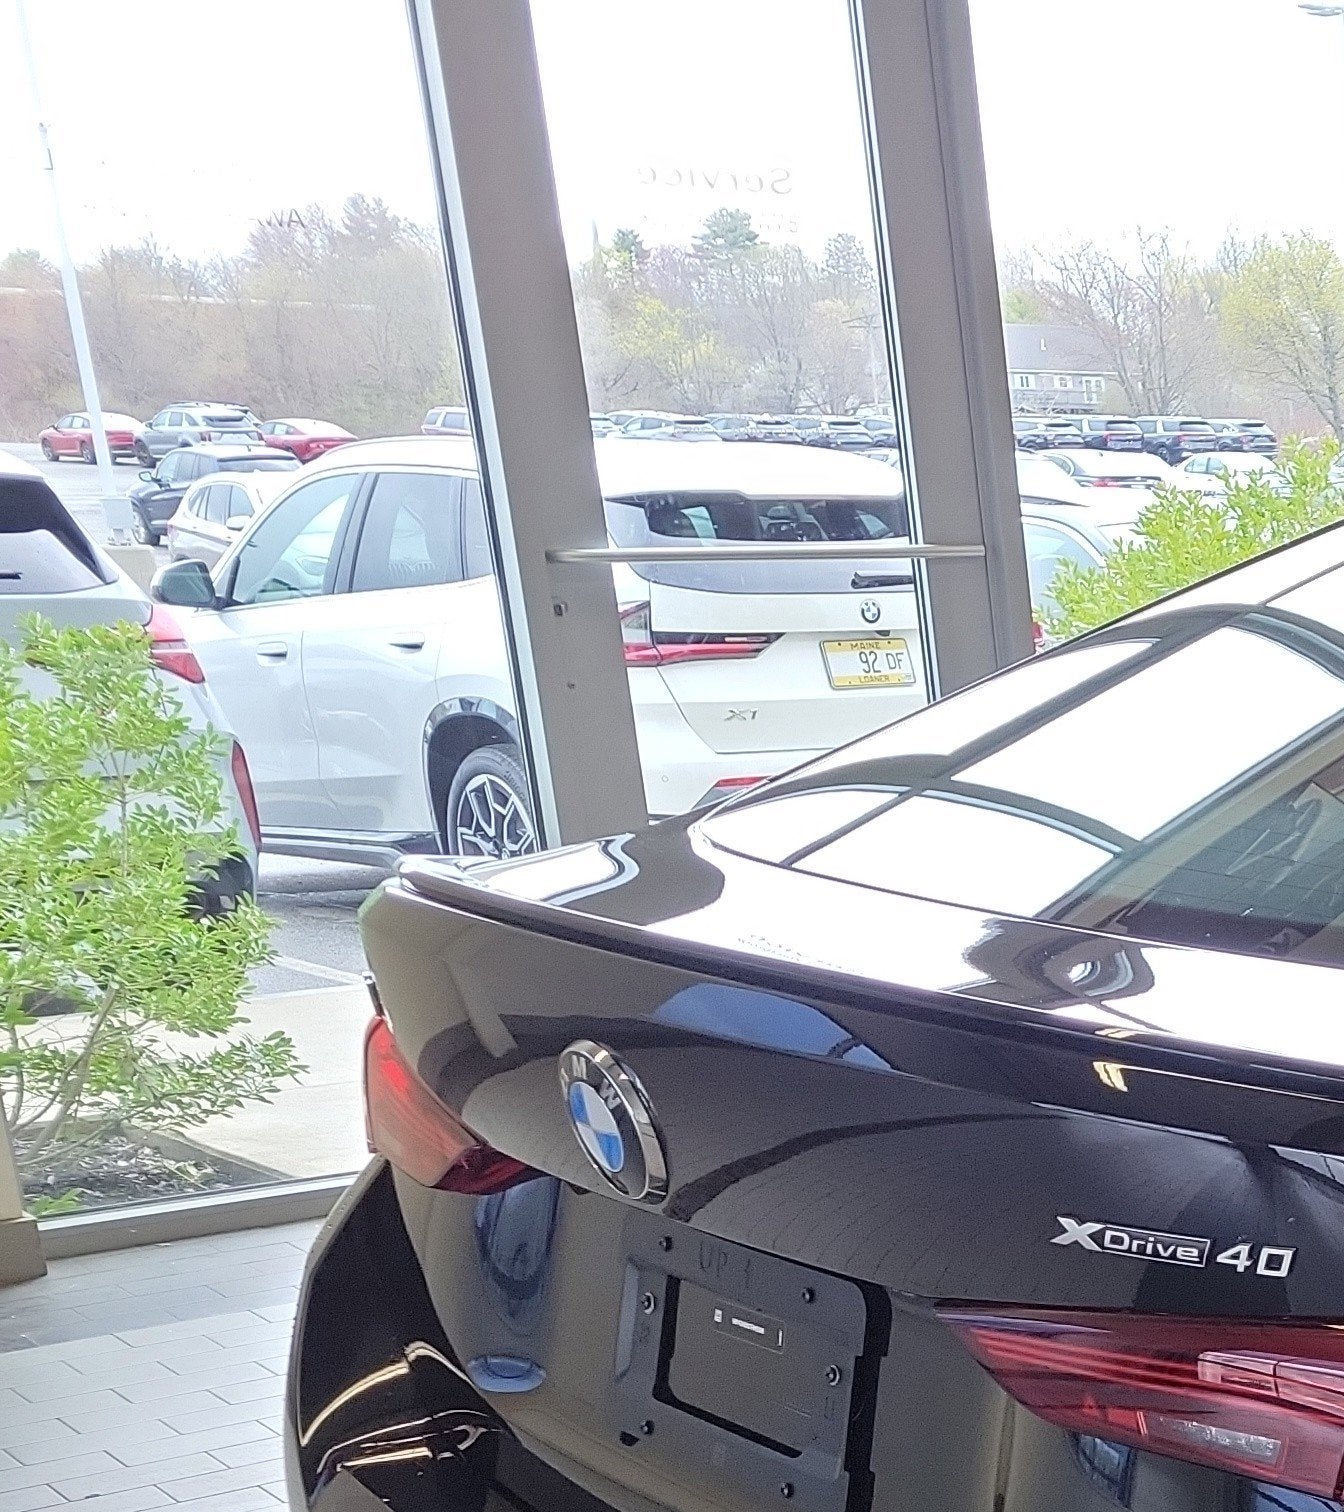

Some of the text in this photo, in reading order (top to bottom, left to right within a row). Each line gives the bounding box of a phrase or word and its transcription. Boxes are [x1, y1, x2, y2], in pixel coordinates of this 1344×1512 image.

[851, 642, 881, 650] MAINE
[859, 650, 904, 674] 92 DF
[858, 675, 891, 683] LOANER
[724, 707, 759, 721] X1
[698, 1242, 728, 1278] UP
[1215, 1240, 1297, 1278] 40
